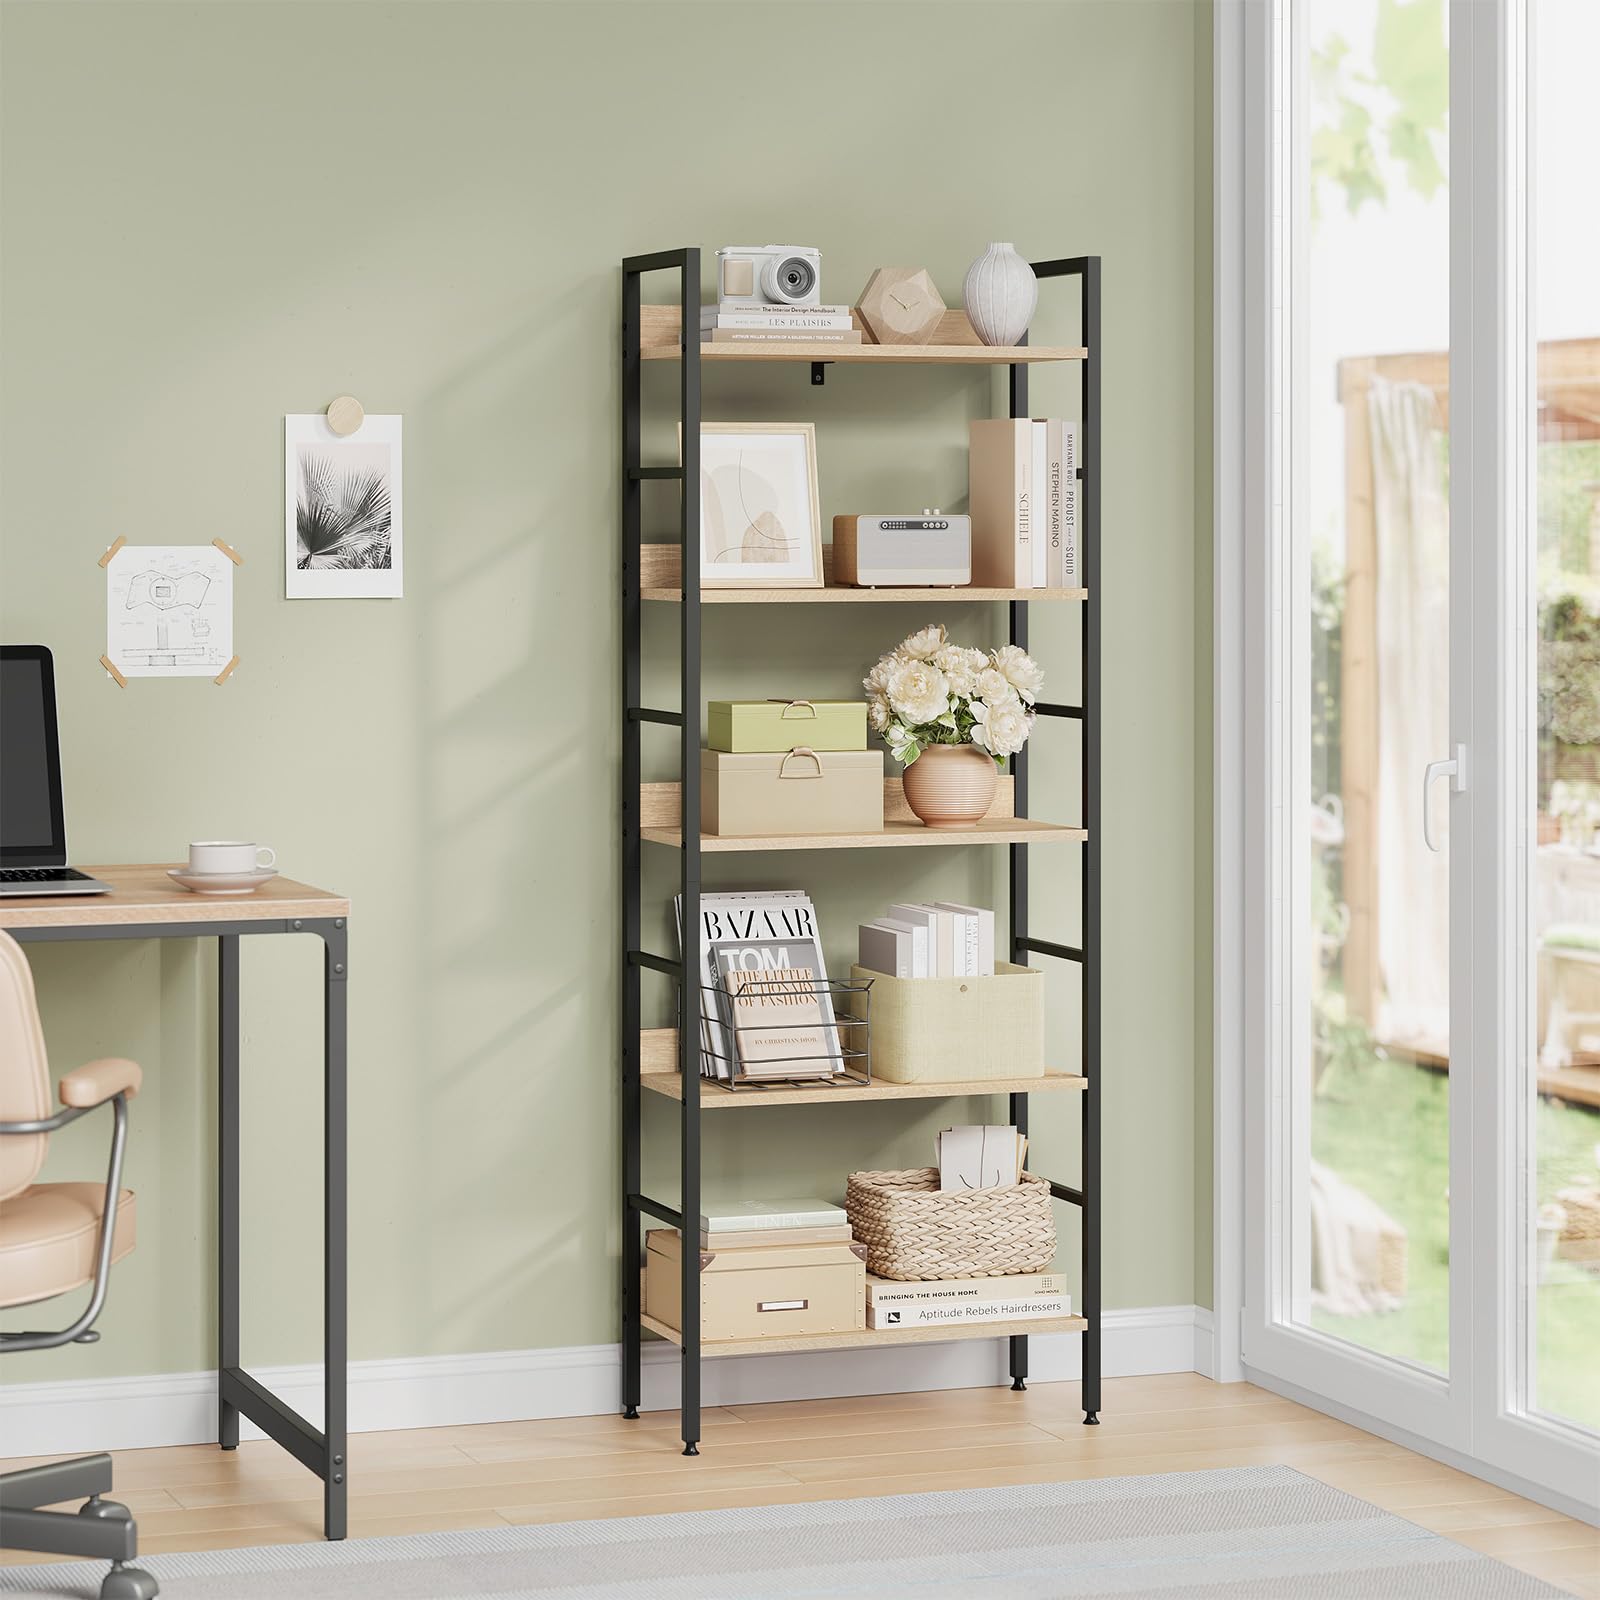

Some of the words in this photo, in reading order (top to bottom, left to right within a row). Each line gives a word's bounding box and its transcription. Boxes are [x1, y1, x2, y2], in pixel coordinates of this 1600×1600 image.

[769, 318, 785, 326] LES
[789, 319, 832, 327] PLAISIRS
[1051, 462, 1060, 507] STEPHEN
[1019, 493, 1029, 544] SCHIELE
[1066, 491, 1074, 526] PROUST
[1051, 508, 1060, 548] MARINO
[1066, 546, 1074, 574] SQUID
[703, 908, 814, 940] BAZAAR
[719, 947, 791, 971] TOM
[733, 970, 762, 982] THE
[764, 968, 813, 981] LITTLE
[736, 981, 814, 996] DICTIONARY
[739, 995, 755, 1007] OF
[760, 993, 818, 1007] FASHION
[878, 1293, 914, 1301] BRINGING
[919, 1308, 963, 1321] Aptitude
[965, 1305, 999, 1316] Rebels
[1001, 1303, 1062, 1314] Hairdressers
